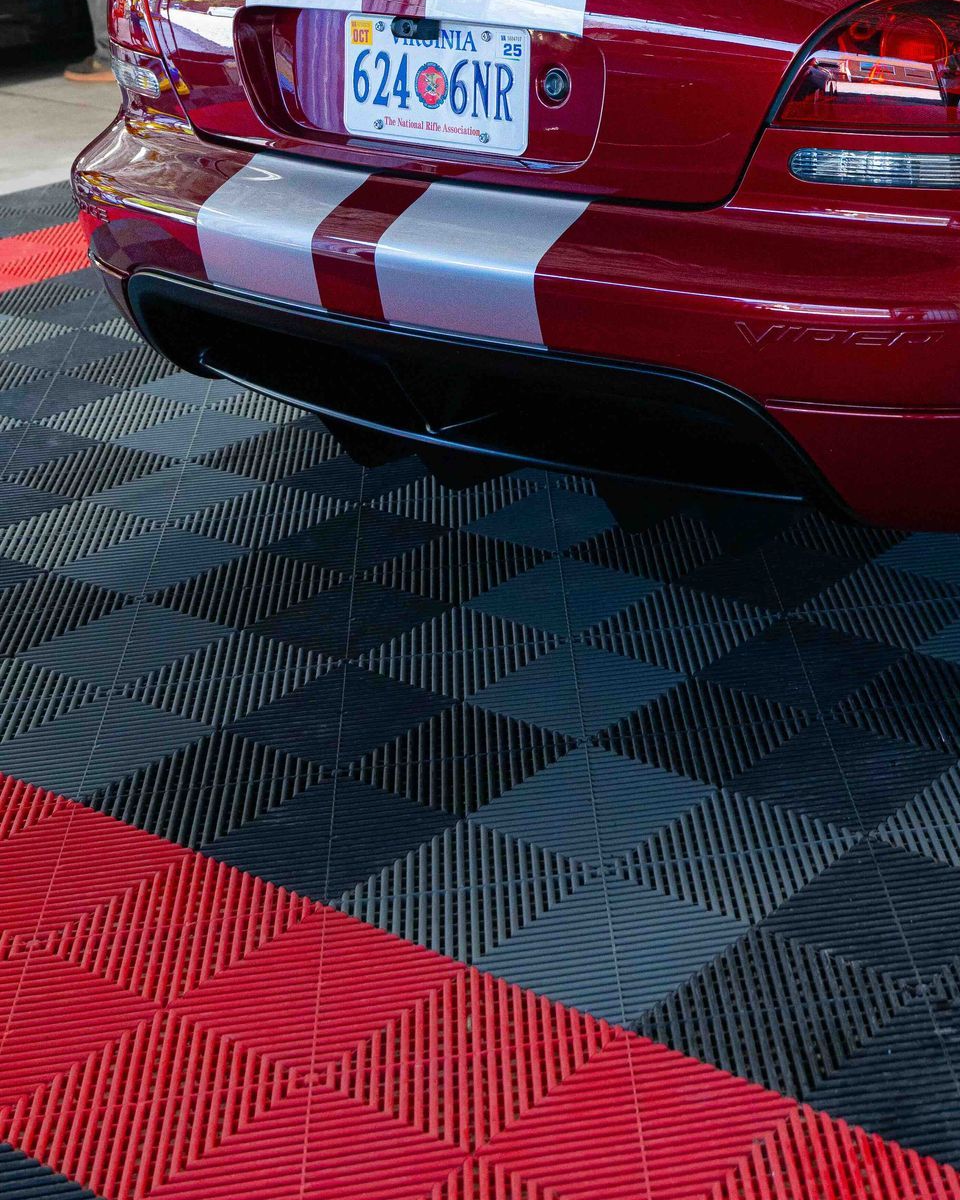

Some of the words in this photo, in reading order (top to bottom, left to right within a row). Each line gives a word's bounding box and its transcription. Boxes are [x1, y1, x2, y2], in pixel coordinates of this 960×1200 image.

[353, 29, 370, 43] OCT
[503, 43, 522, 57] 25
[353, 49, 410, 109] 624
[449, 59, 514, 121] 6NR
[384, 116, 396, 126] The
[398, 117, 424, 130] National
[426, 121, 441, 132] Rifle
[442, 123, 481, 137] Association
